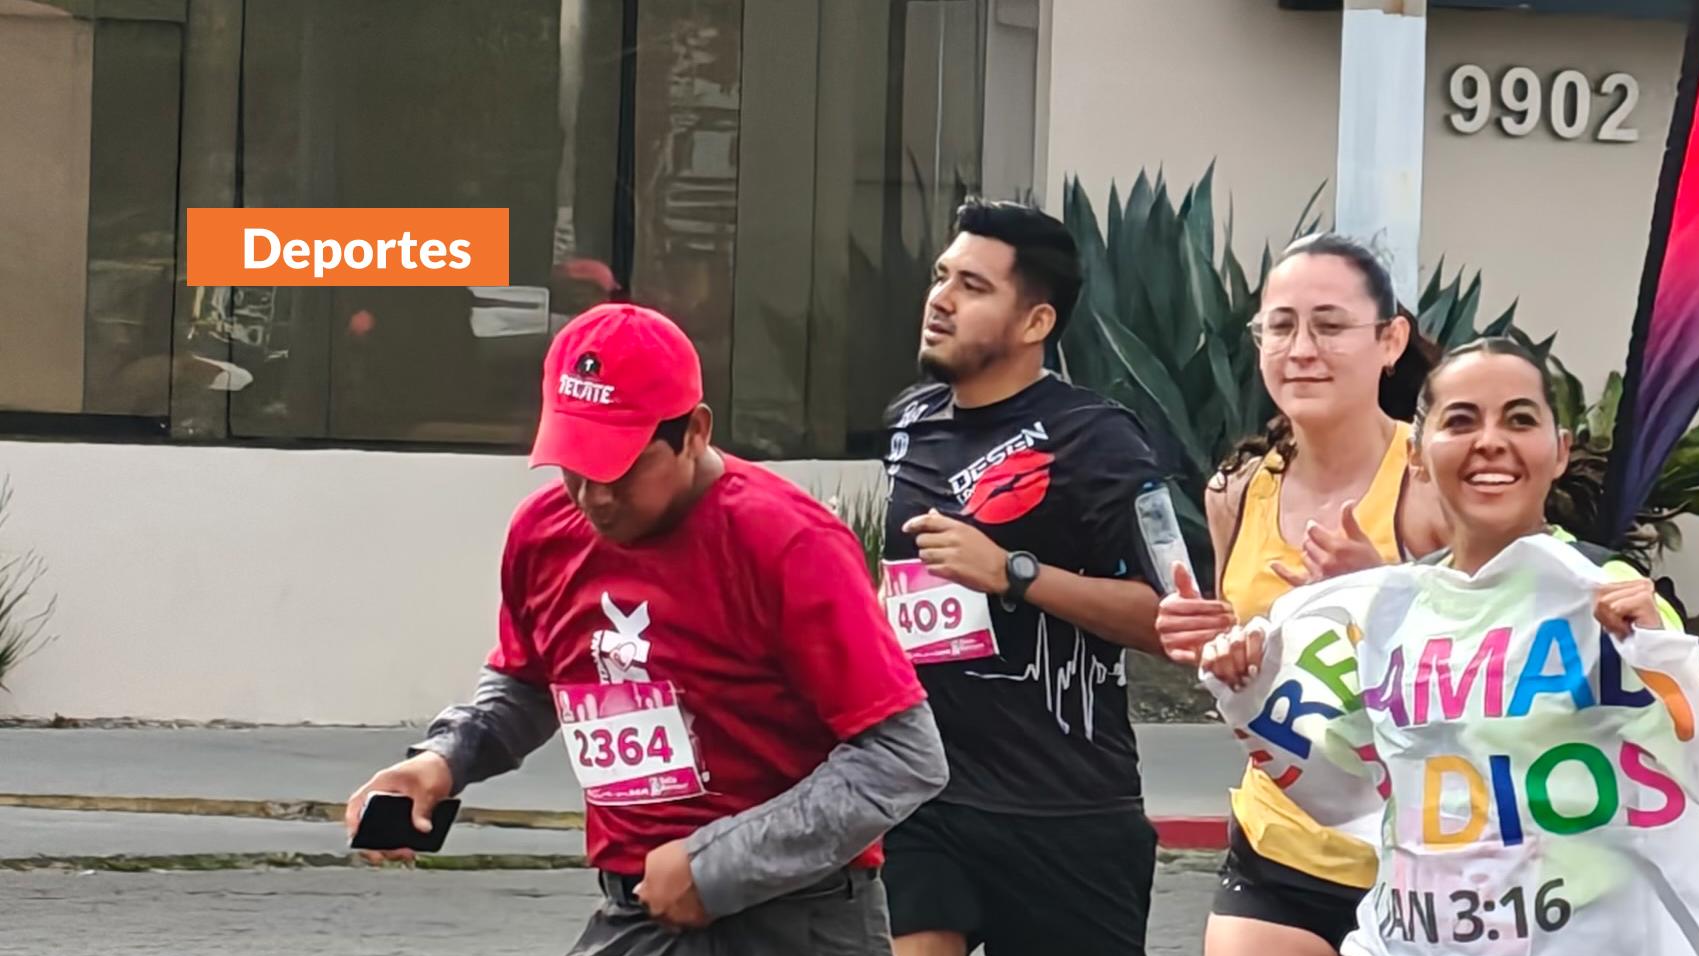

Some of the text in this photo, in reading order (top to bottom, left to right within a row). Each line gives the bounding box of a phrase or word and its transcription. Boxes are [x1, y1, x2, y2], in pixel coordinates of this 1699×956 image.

[1448, 63, 1640, 142] 9902
[558, 373, 616, 404] TECATE
[897, 596, 963, 633] 409
[573, 724, 675, 769] 2364
[1422, 741, 1686, 846] DIOS
[1449, 878, 1572, 943] 3:16
